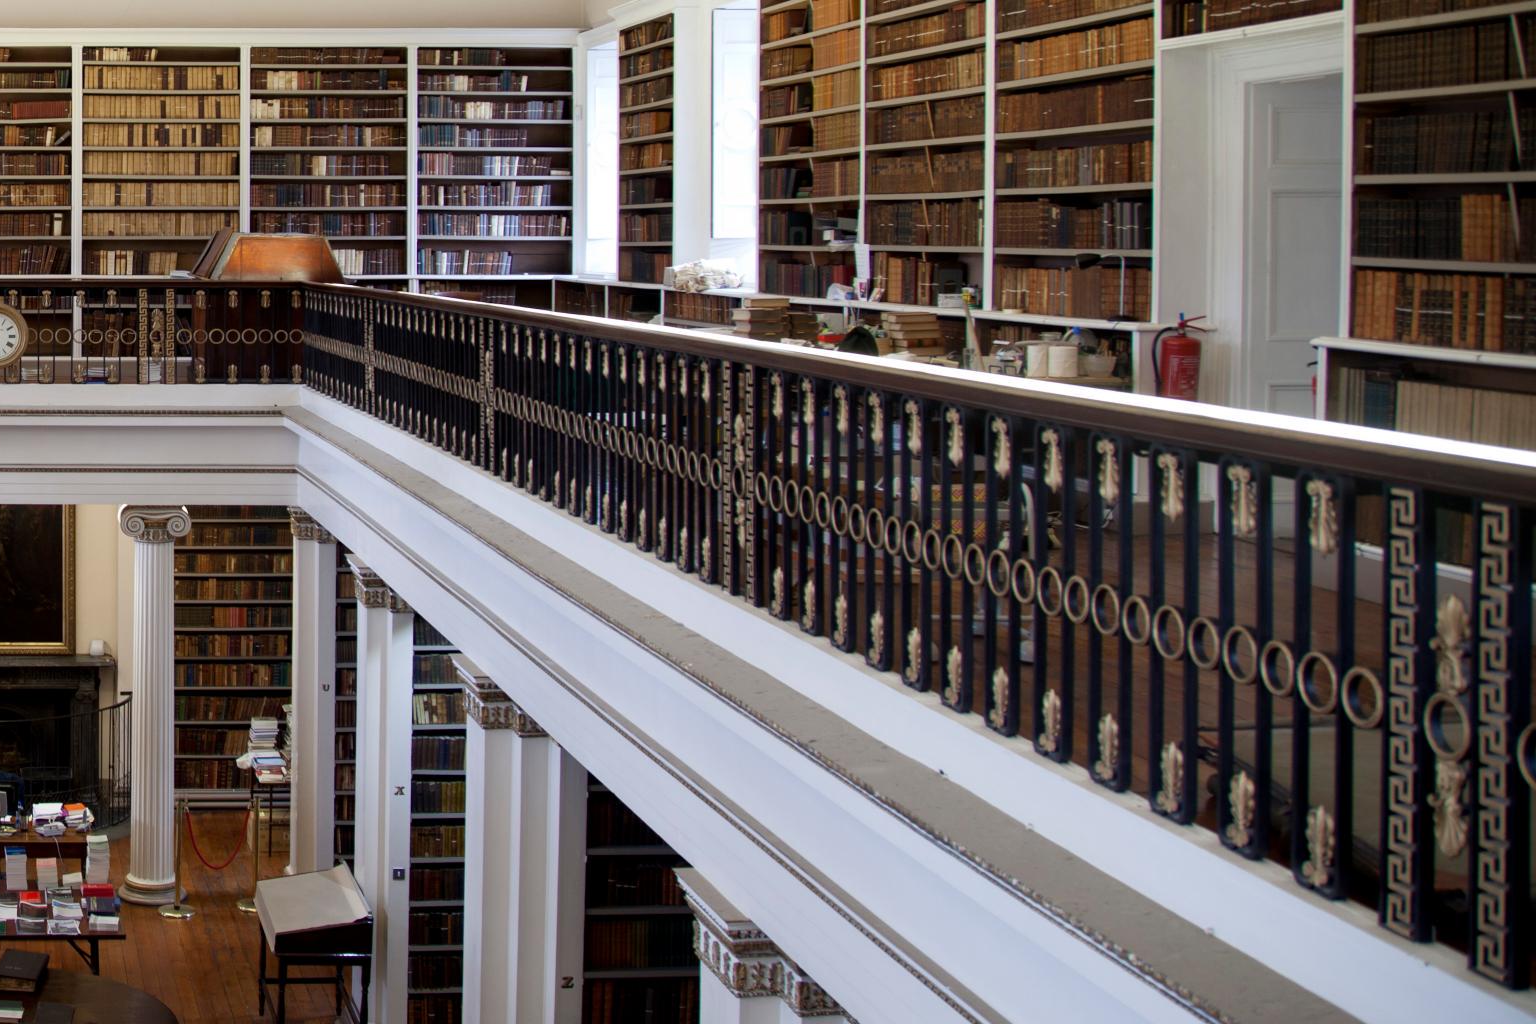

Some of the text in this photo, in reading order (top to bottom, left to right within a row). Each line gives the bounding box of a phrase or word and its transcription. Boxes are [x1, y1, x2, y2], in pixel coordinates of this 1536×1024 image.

[322, 684, 330, 692] U
[394, 786, 405, 796] X
[561, 976, 575, 989] Z
